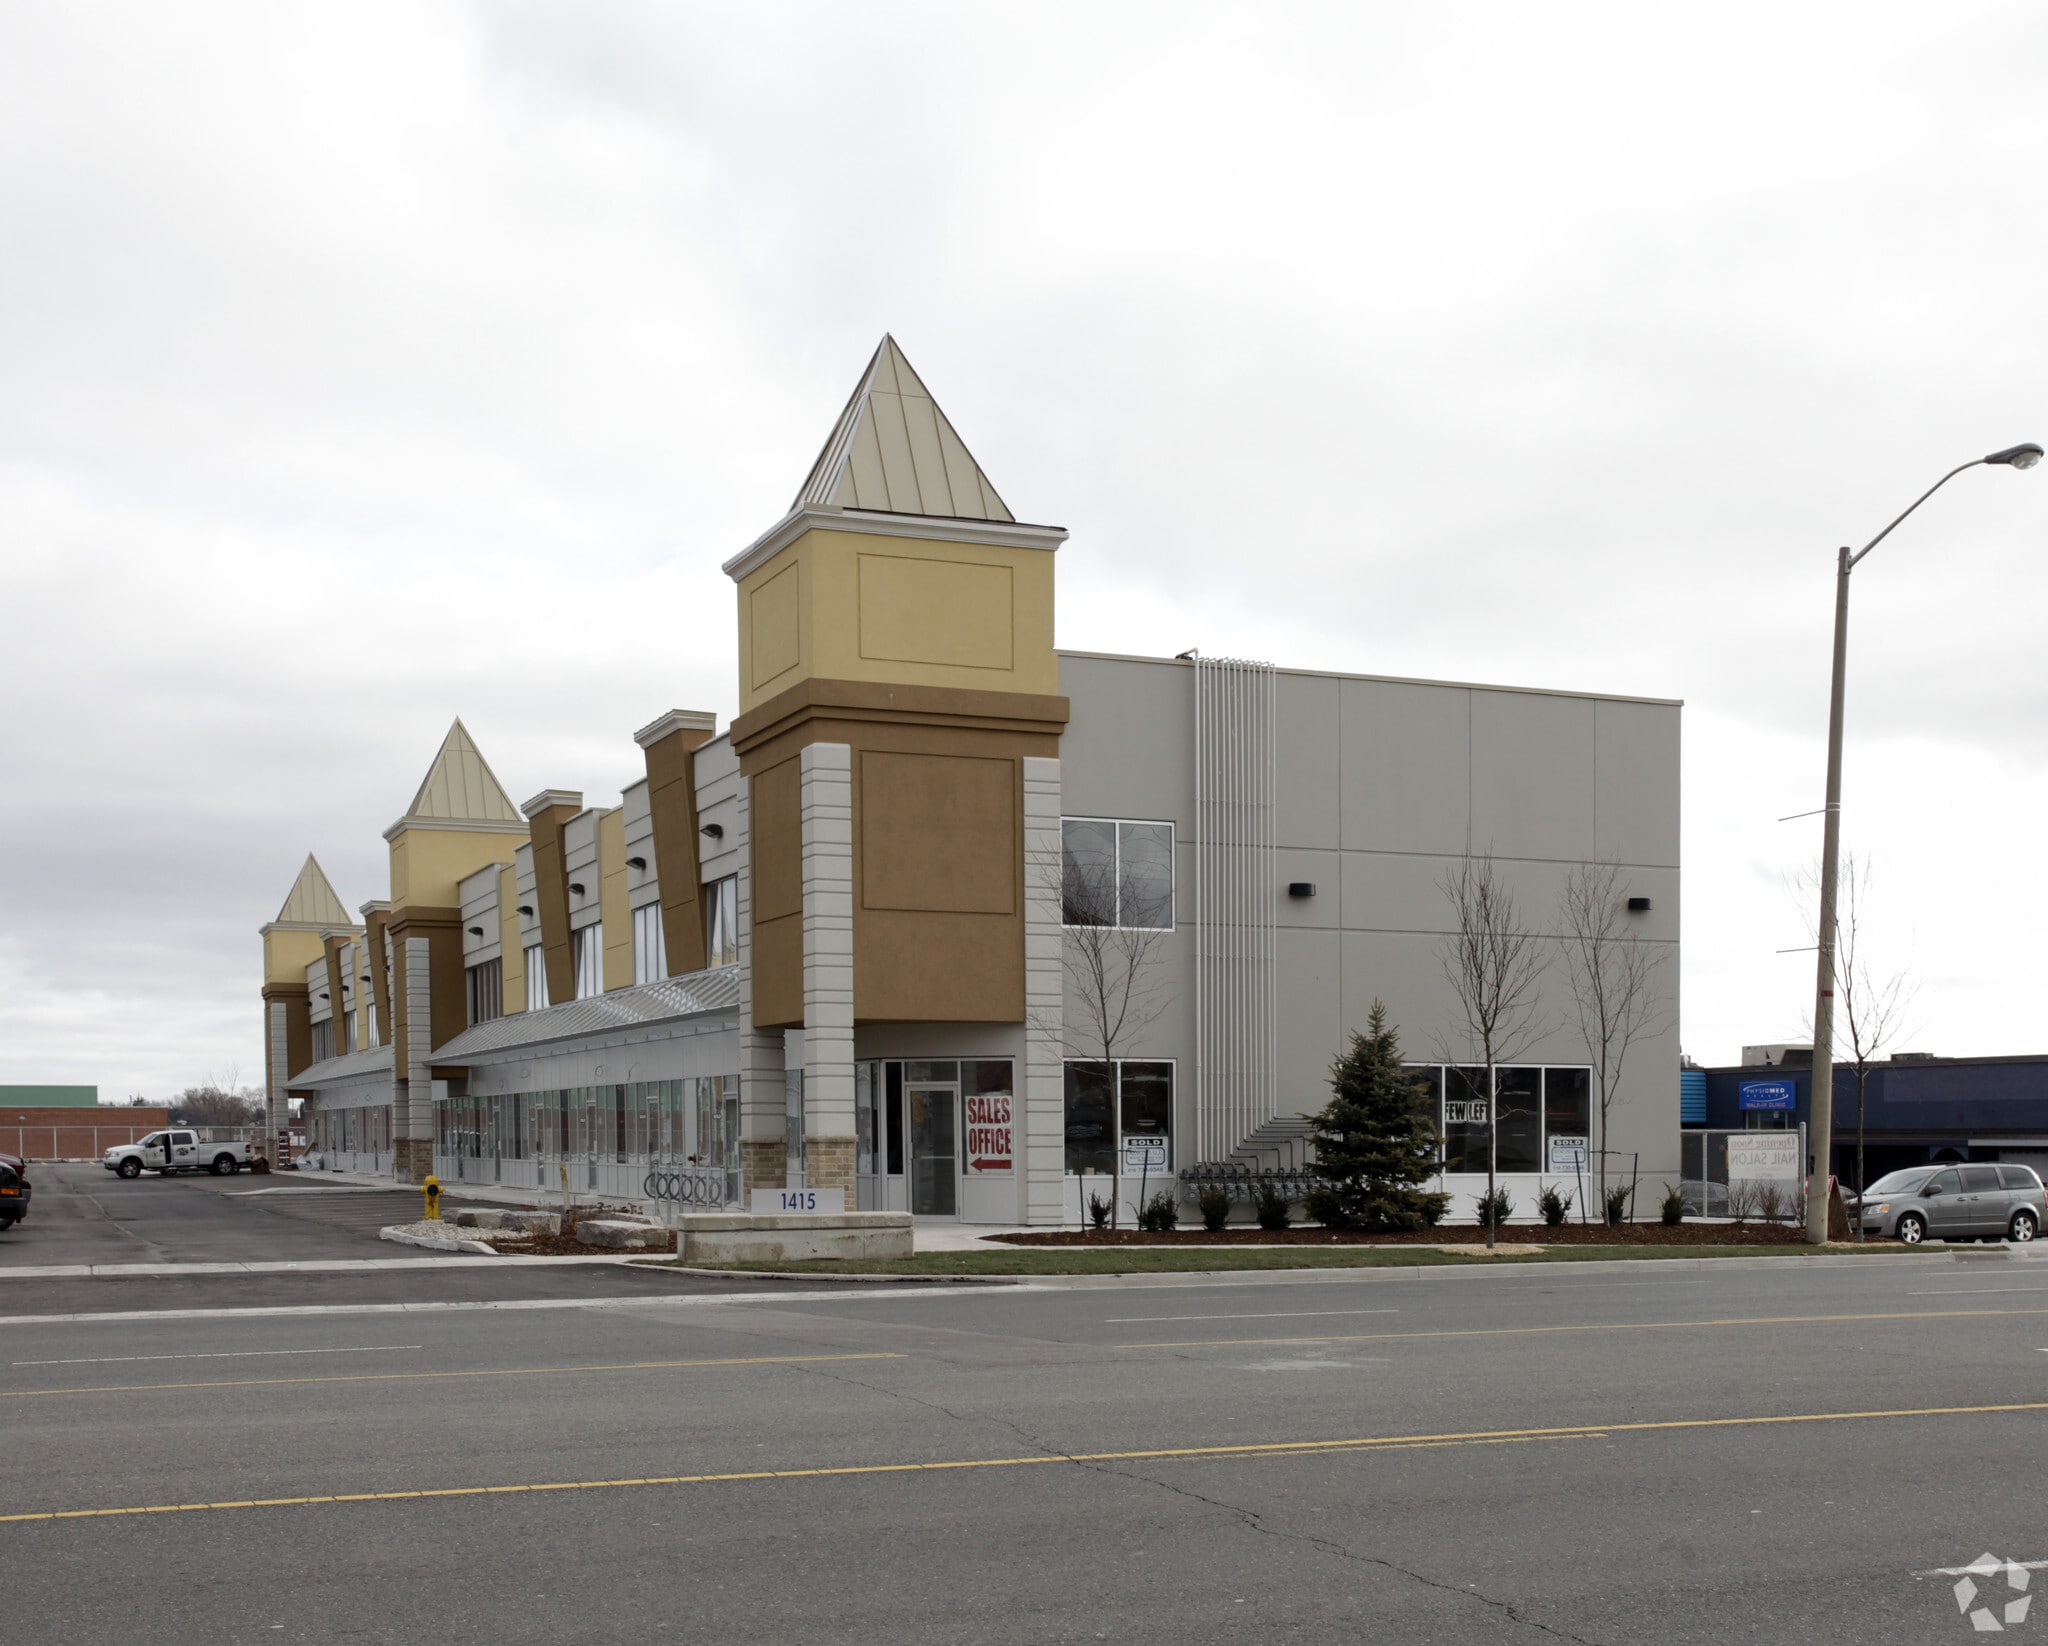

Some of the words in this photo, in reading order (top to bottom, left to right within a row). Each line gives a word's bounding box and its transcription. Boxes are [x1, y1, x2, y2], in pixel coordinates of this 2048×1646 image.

[967, 1097, 1011, 1125] SALES
[1445, 1103, 1466, 1120] FEW
[968, 1128, 1012, 1155] OFFICE
[781, 1192, 816, 1210] 1415
